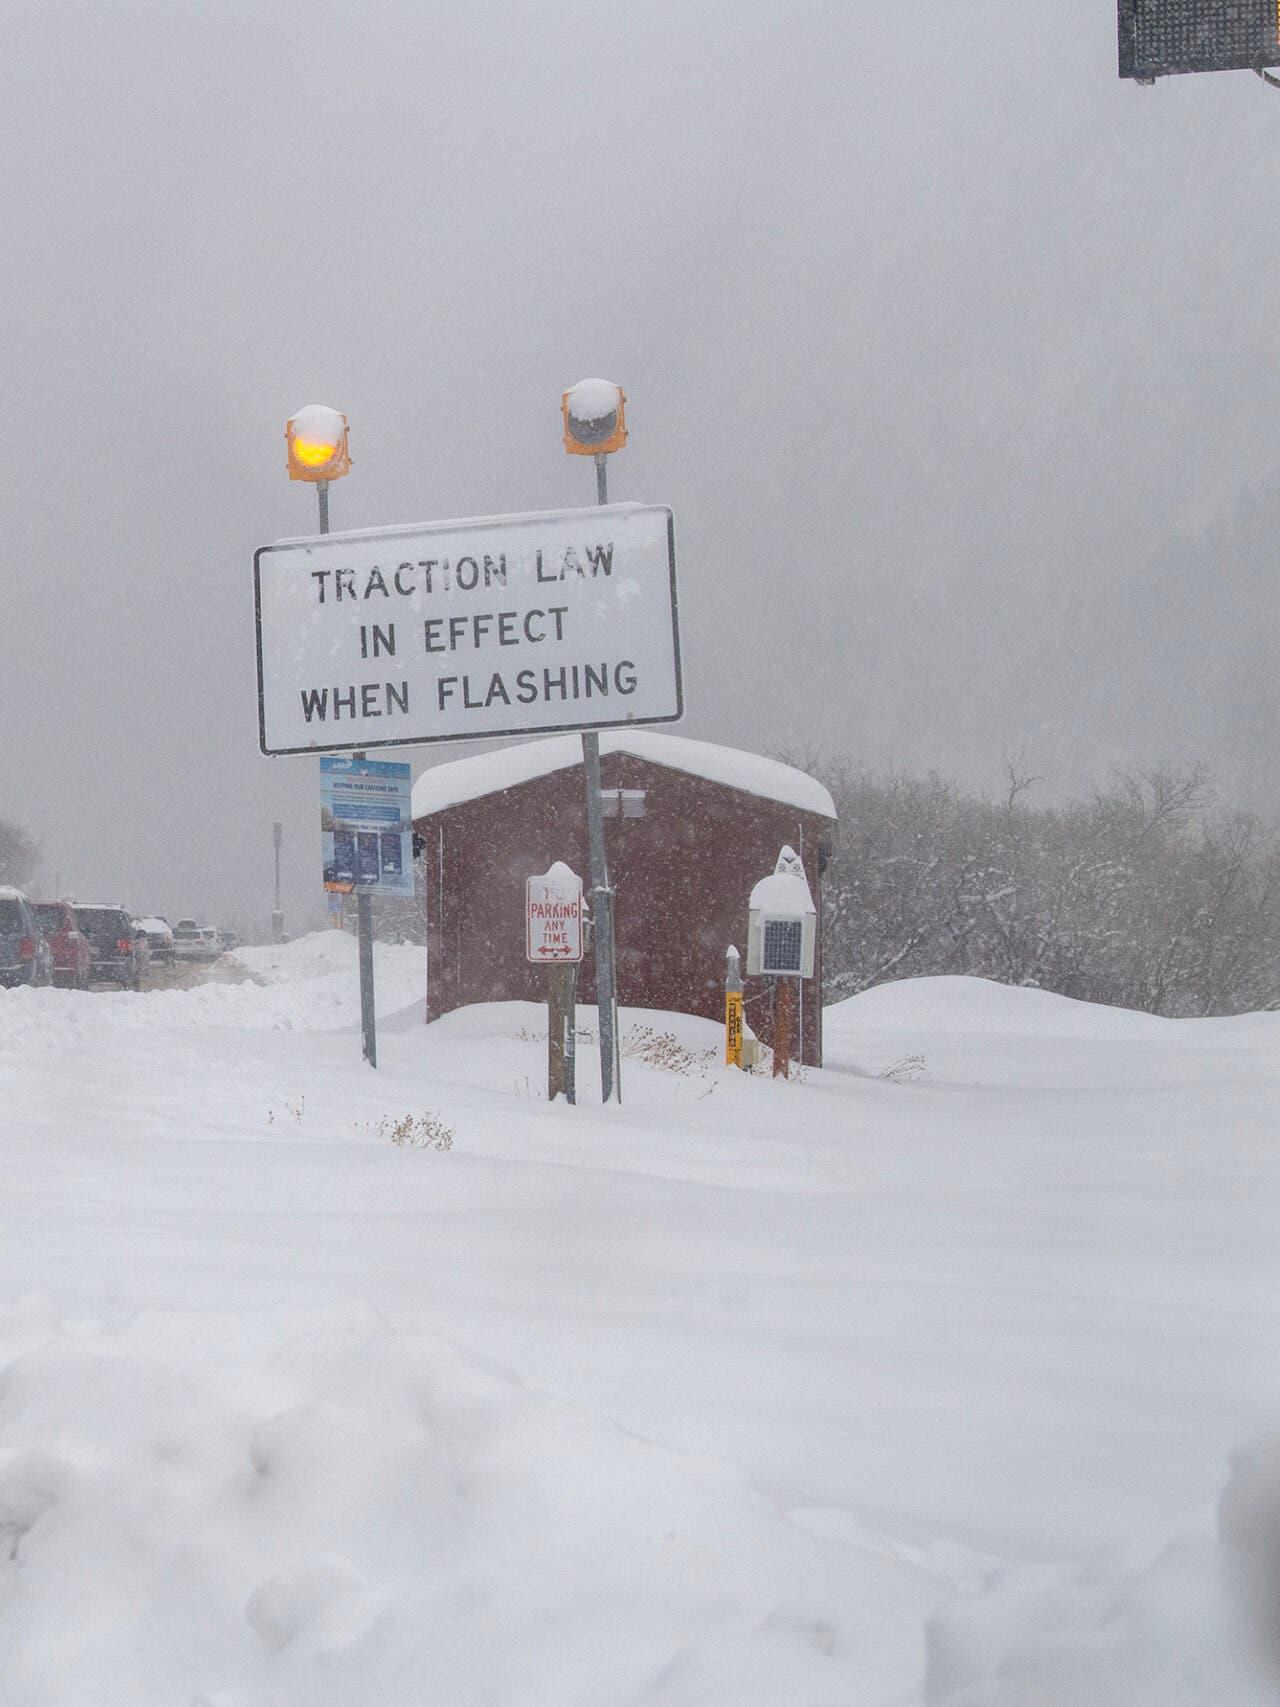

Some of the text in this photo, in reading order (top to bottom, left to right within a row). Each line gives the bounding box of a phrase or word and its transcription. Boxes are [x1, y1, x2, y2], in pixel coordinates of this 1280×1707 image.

[311, 542, 614, 604] TRACTION LAW
[360, 607, 568, 658] IN EFFECT
[300, 660, 637, 722] WHEN FLASHING
[531, 903, 577, 918] PARKING
[545, 921, 565, 931] ANY
[542, 933, 568, 944] TIME
